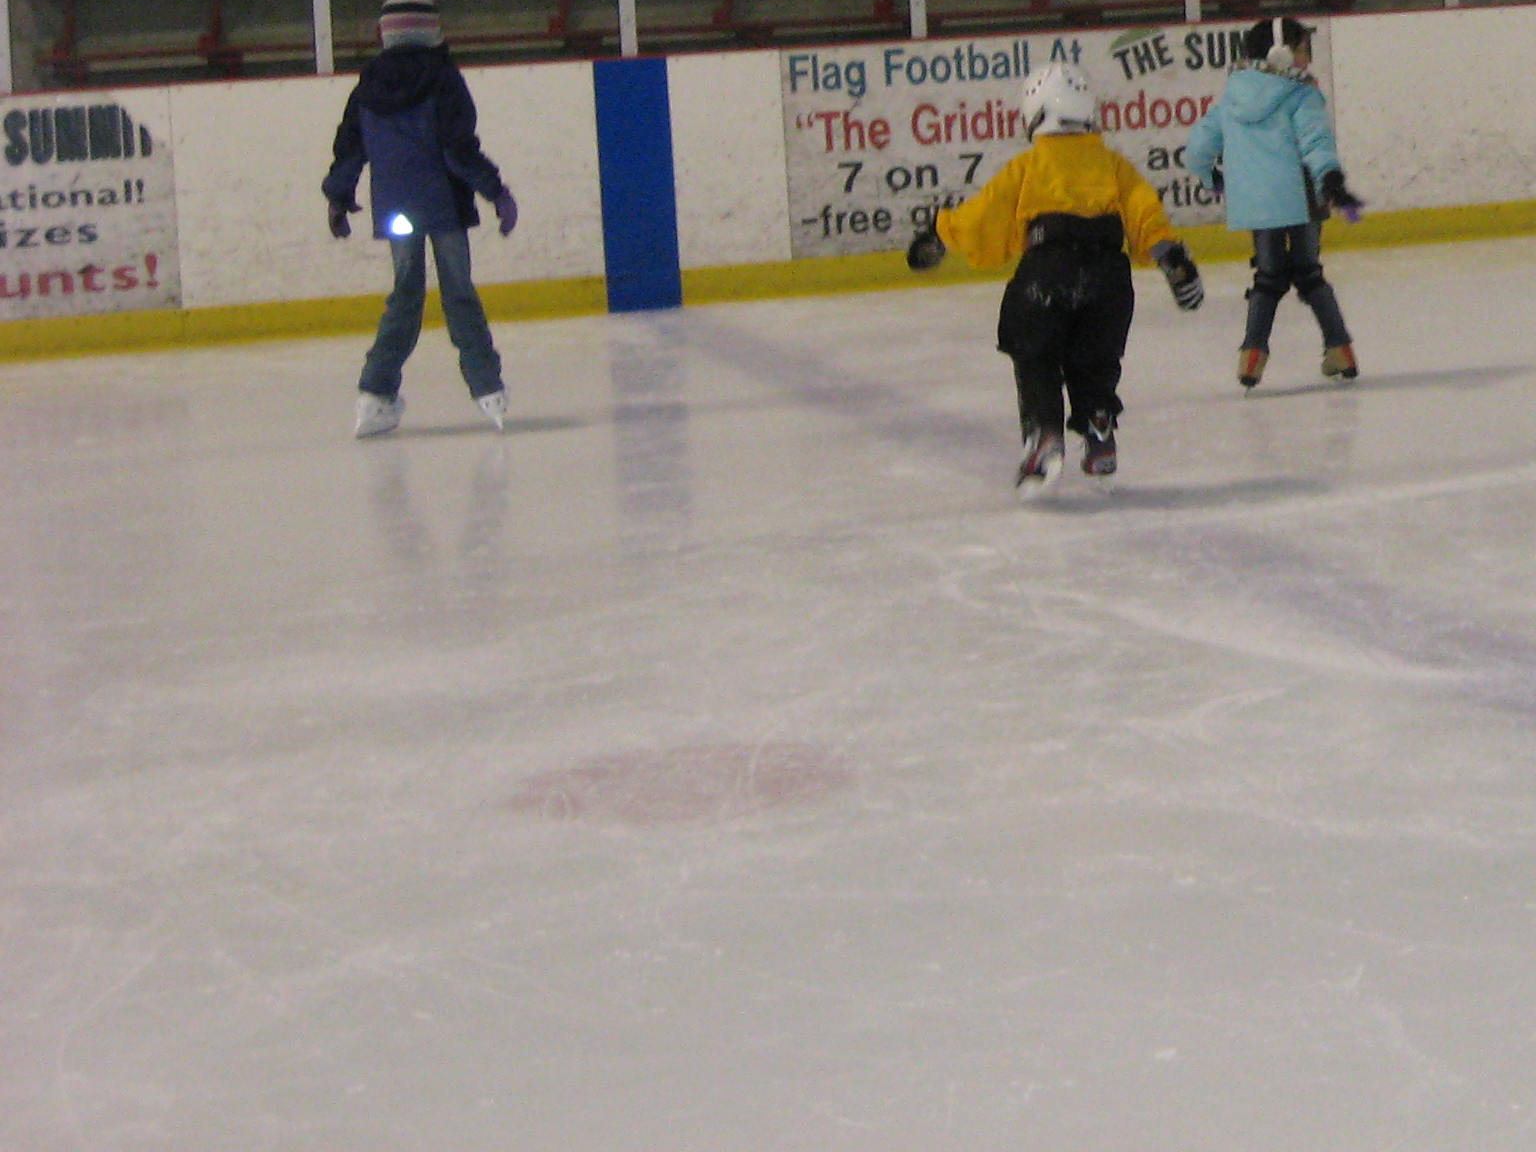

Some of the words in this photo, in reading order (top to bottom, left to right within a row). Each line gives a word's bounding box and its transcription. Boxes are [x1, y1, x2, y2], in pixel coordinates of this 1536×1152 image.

[789, 53, 867, 97] Flag
[884, 40, 1030, 87] Football
[1113, 34, 1174, 80] THE
[837, 161, 863, 193] 7
[885, 162, 939, 192] on
[959, 152, 983, 185] 7
